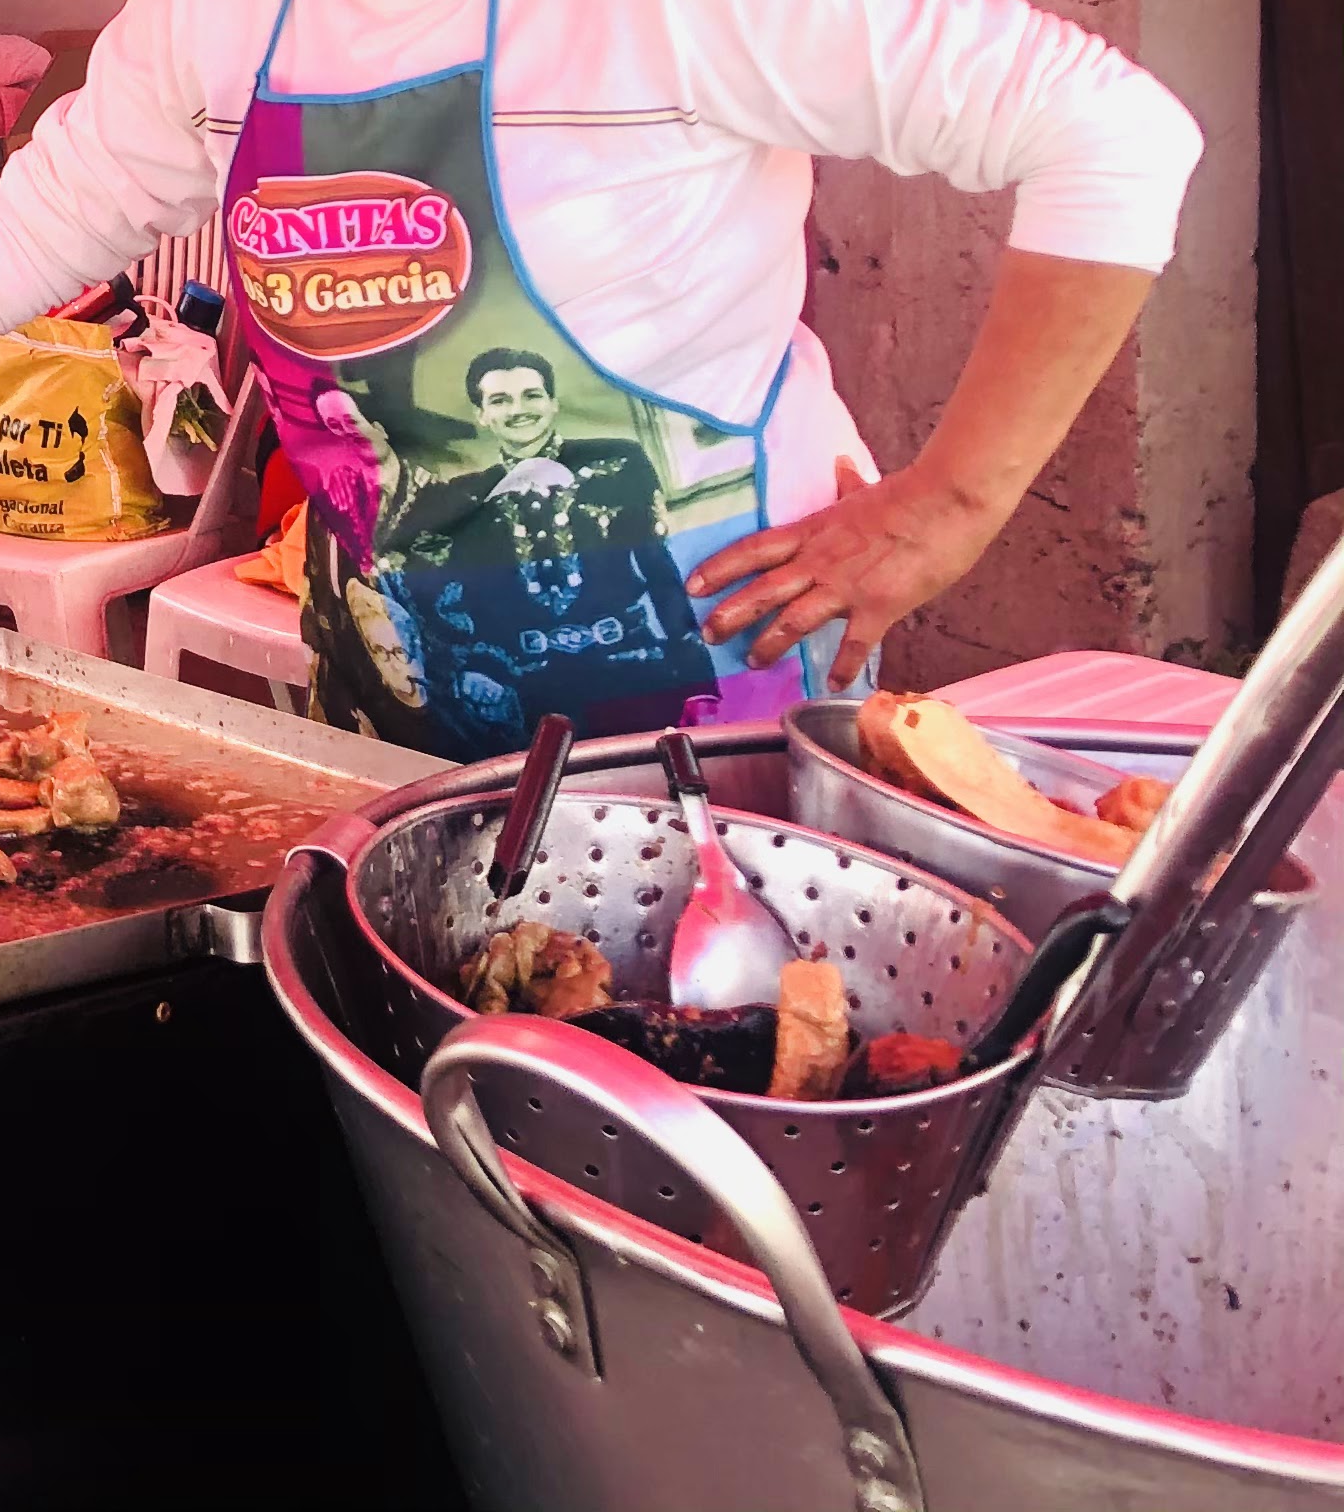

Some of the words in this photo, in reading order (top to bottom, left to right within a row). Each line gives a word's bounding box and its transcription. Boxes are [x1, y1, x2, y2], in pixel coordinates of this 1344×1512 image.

[266, 273, 296, 316] 3
[304, 261, 457, 313] Garcia
[38, 418, 64, 449] Ti
